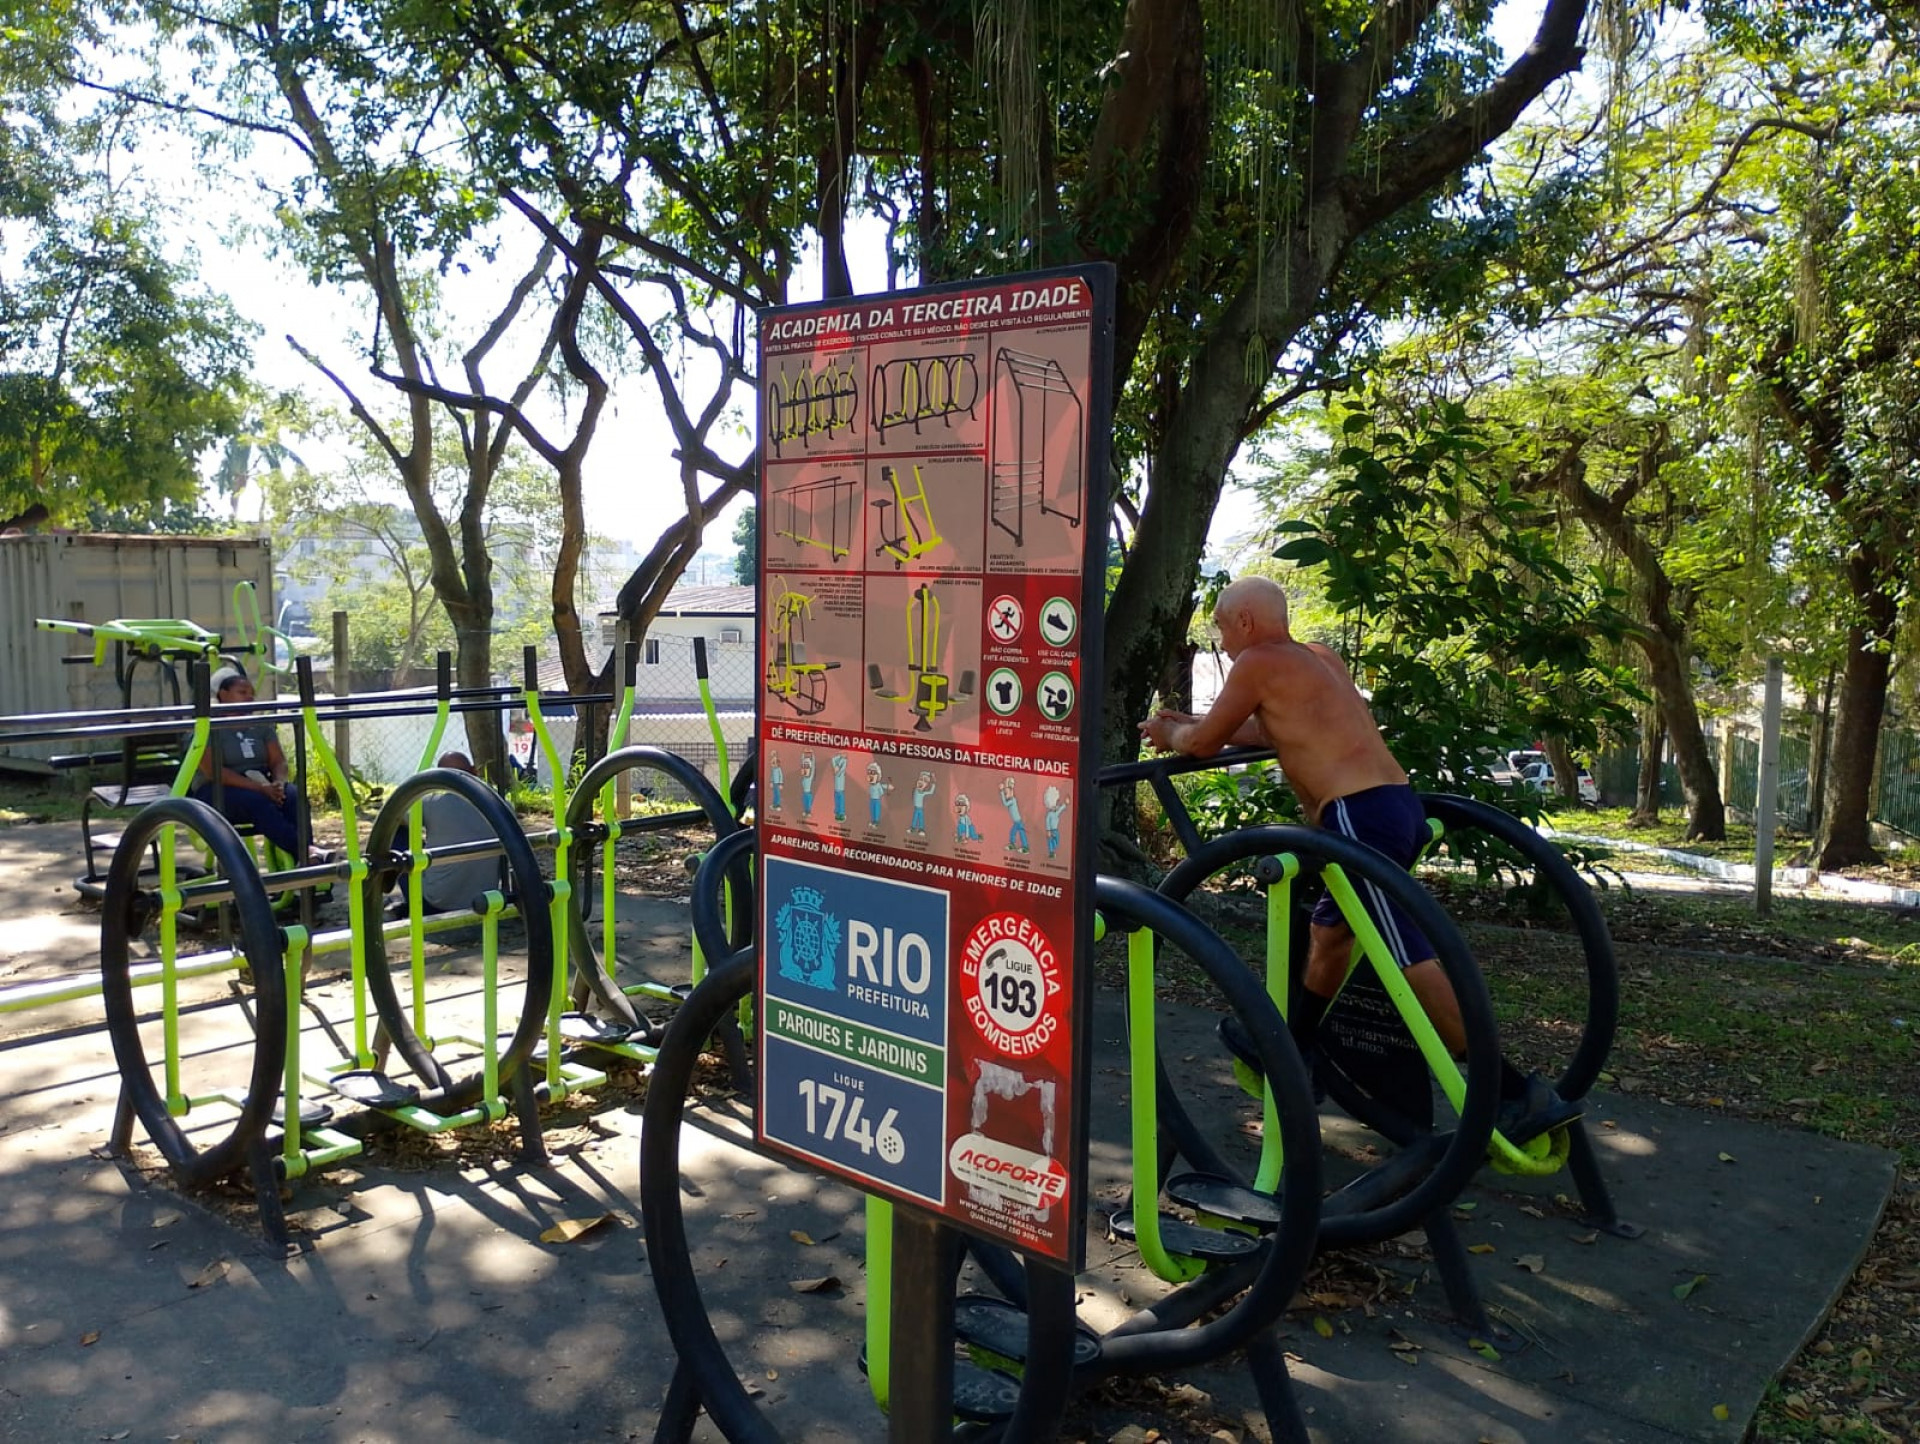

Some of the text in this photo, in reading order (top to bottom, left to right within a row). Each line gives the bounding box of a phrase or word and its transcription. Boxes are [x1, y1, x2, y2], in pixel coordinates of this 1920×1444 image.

[769, 283, 1081, 341] ACADEMIA DA TERCEIRA IDADE
[880, 329, 912, 339] CONSULTE
[913, 327, 926, 336] SEU
[969, 321, 989, 330] DEIXE
[989, 319, 1000, 328] DE
[1034, 309, 1090, 322] REGULARMENTE
[1041, 658, 1073, 667] ADEQUADO
[771, 725, 784, 739] DÊ
[785, 727, 851, 747] PREFERÊNCIA
[852, 737, 880, 751] PARA
[882, 741, 897, 754] AS
[900, 743, 952, 760] PESSOAS
[954, 749, 971, 763] DA
[973, 751, 1032, 771] TERCEIRA
[1033, 758, 1070, 775] IDADE
[770, 834, 1063, 898] APARELHOS NÃO RECOMENDADOS PARA MENORES DE IDADE
[848, 919, 931, 995] RIO
[963, 916, 1061, 996] EMERGÊNCIA
[1005, 959, 1033, 975] LIGUE
[847, 983, 930, 1020] PREFEITURA
[984, 972, 1037, 1018] 193
[778, 1009, 928, 1074] PARQUES E JARDINS
[966, 994, 1057, 1055] BOMBEIROS
[833, 1071, 865, 1091] LIGUE
[798, 1078, 906, 1164] 1746
[958, 1149, 1062, 1193] AÇOFORTE
[969, 1211, 1007, 1231] QUALIDADE
[1008, 1226, 1021, 1235] ISO
